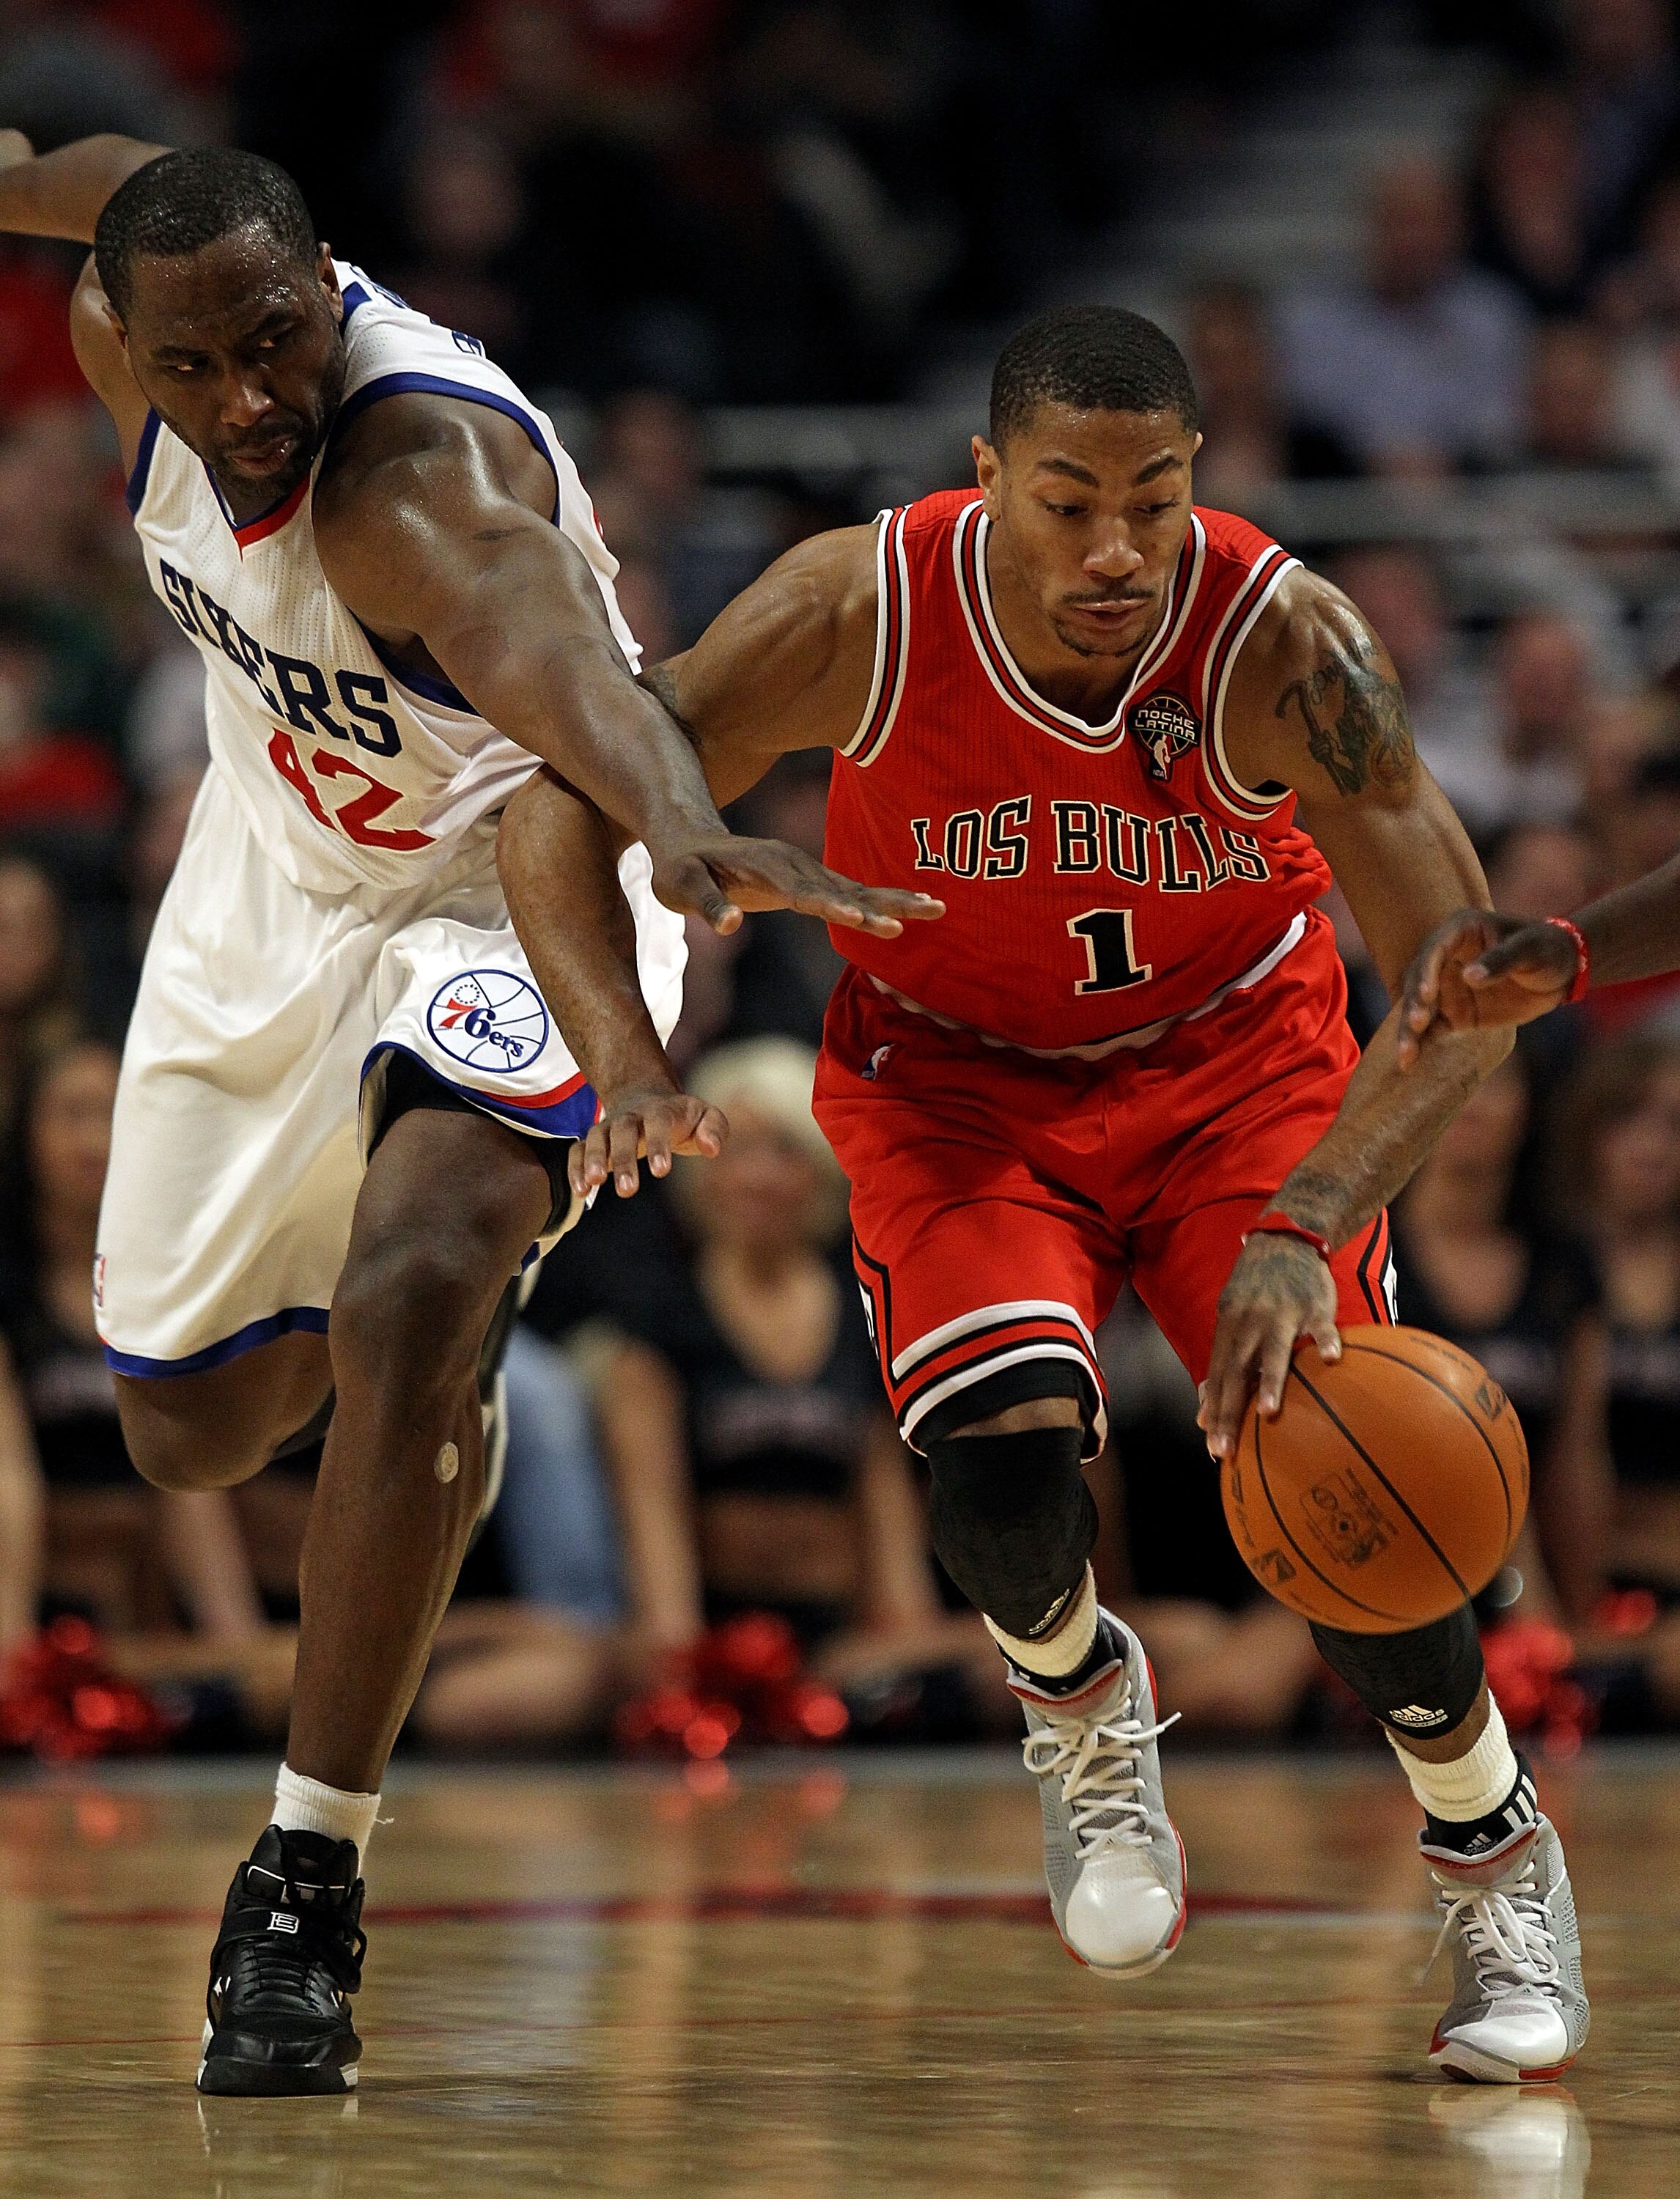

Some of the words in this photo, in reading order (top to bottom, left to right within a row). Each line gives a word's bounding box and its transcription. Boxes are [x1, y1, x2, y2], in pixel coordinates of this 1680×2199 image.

[1135, 718, 1195, 741] LATINA
[1138, 709, 1195, 730] NOCHE
[268, 727, 438, 851] 42
[910, 794, 1032, 880] LOS
[1050, 800, 1272, 893] BULLS
[1066, 908, 1153, 995] 1
[1389, 1709, 1445, 1722] adidas
